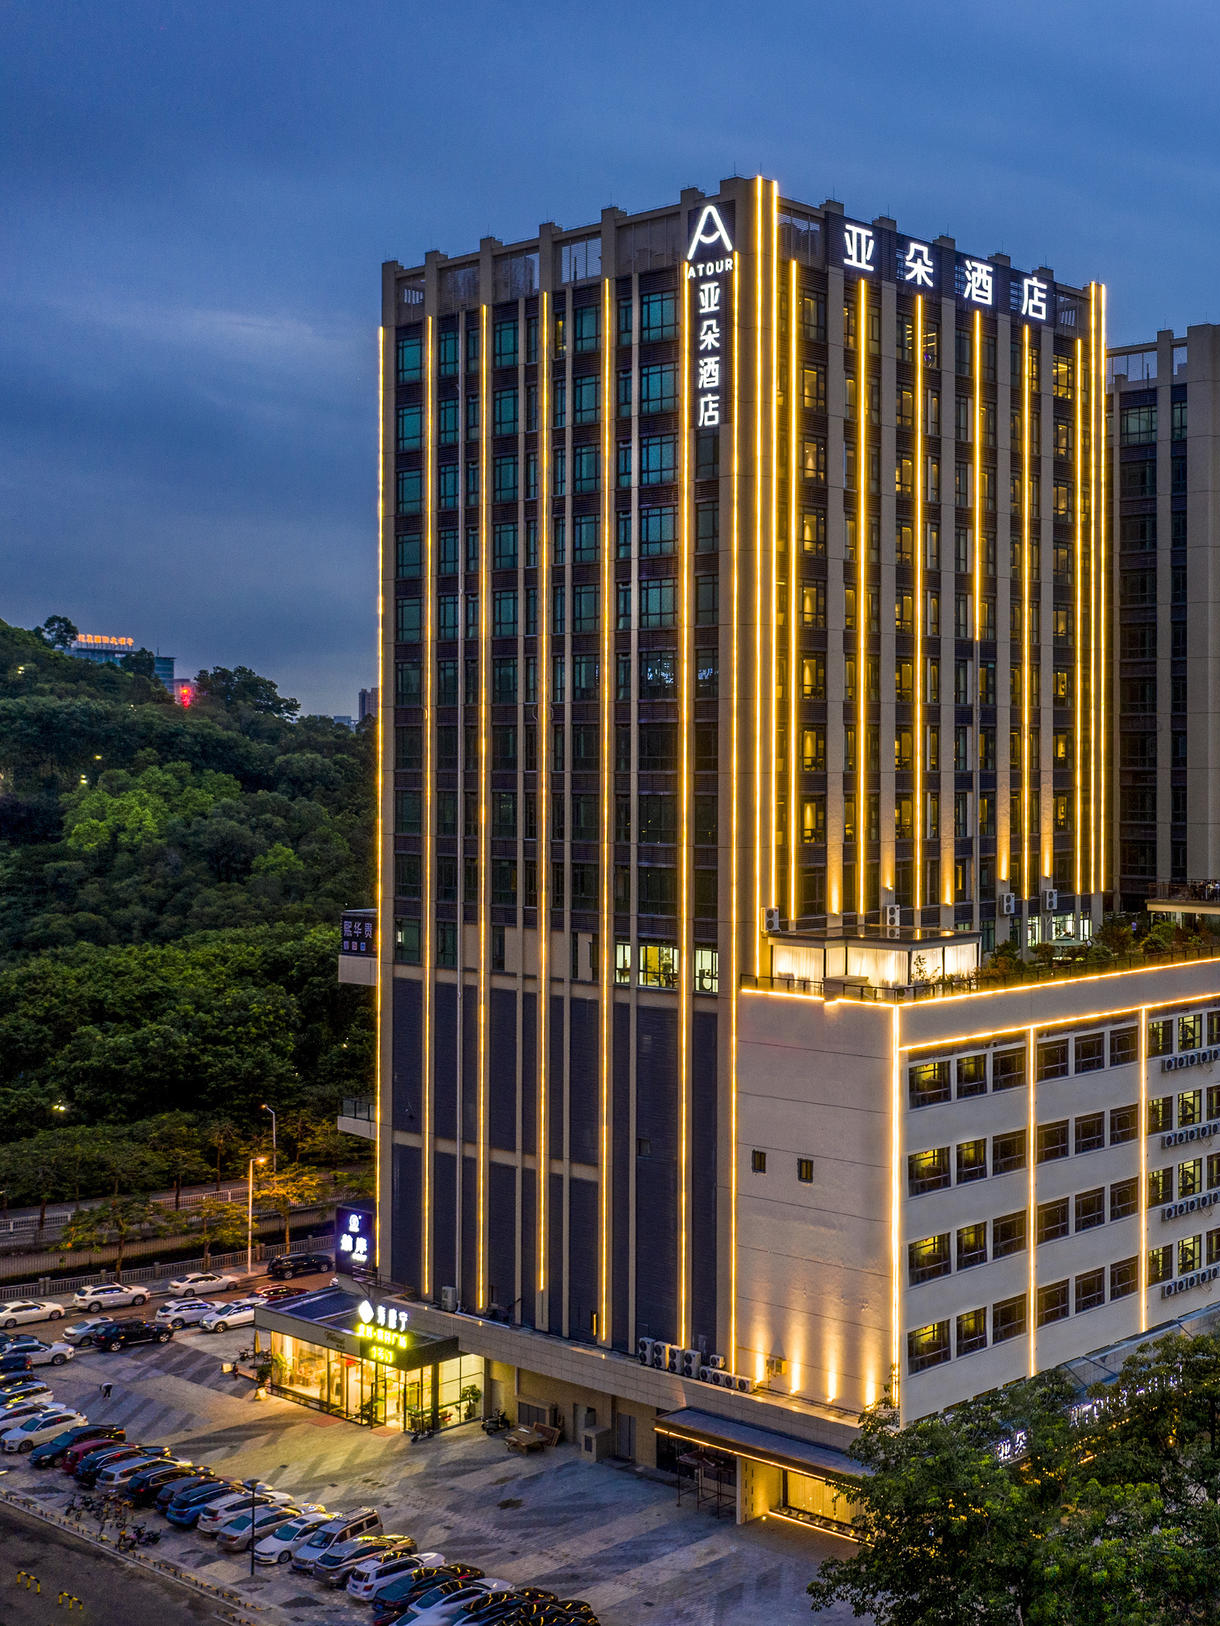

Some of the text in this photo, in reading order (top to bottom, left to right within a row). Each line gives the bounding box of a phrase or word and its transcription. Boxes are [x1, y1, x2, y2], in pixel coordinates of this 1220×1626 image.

[687, 258, 734, 279] ATOUR
[843, 224, 1048, 321] 亚朵酒店
[698, 282, 720, 427] 亚朵酒店
